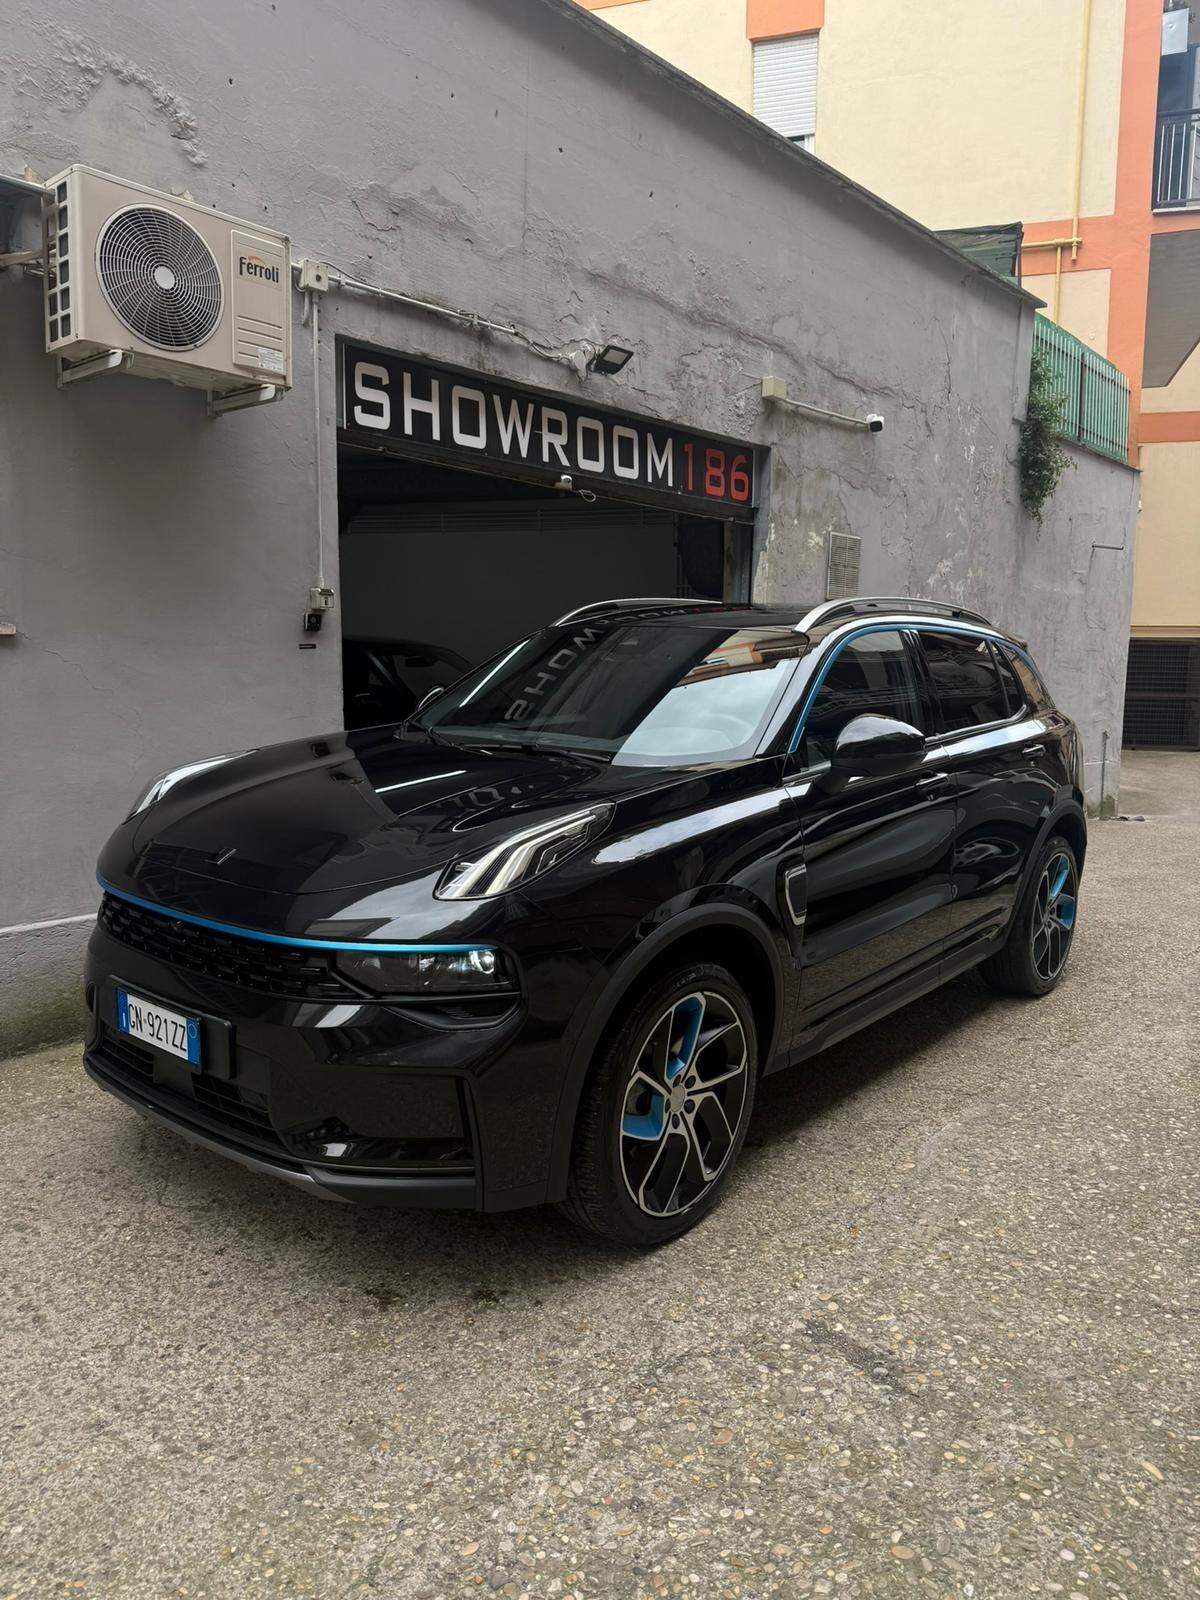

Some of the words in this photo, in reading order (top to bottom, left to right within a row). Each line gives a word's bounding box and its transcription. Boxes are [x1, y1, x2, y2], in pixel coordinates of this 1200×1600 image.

[239, 256, 279, 283] Ferroli
[354, 361, 673, 487] SHOWROOM
[684, 443, 749, 501] 186
